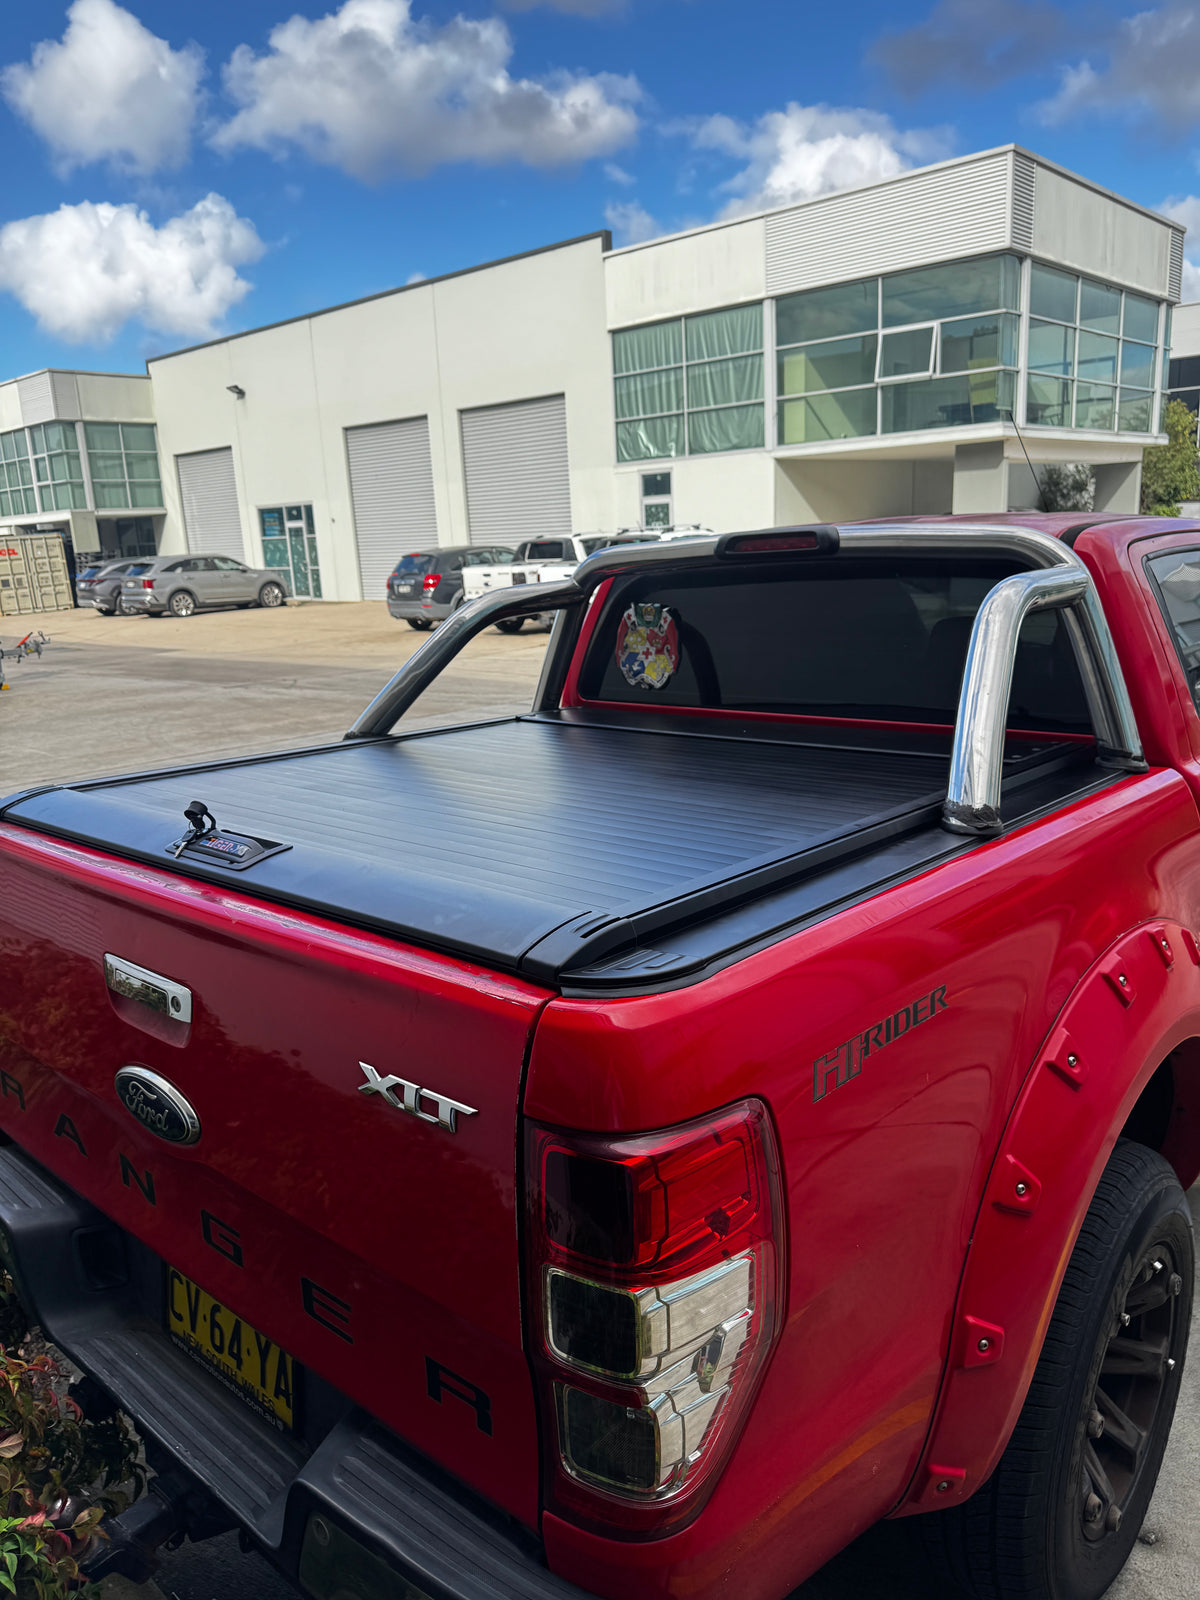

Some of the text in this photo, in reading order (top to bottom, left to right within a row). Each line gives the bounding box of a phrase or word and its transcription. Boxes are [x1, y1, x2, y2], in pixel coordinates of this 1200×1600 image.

[125, 1080, 169, 1132] Ford
[358, 1061, 479, 1134] XLT
[0, 1069, 494, 1437] RANGER
[206, 1348, 238, 1380] SOUTH
[241, 1376, 276, 1412] WALES
